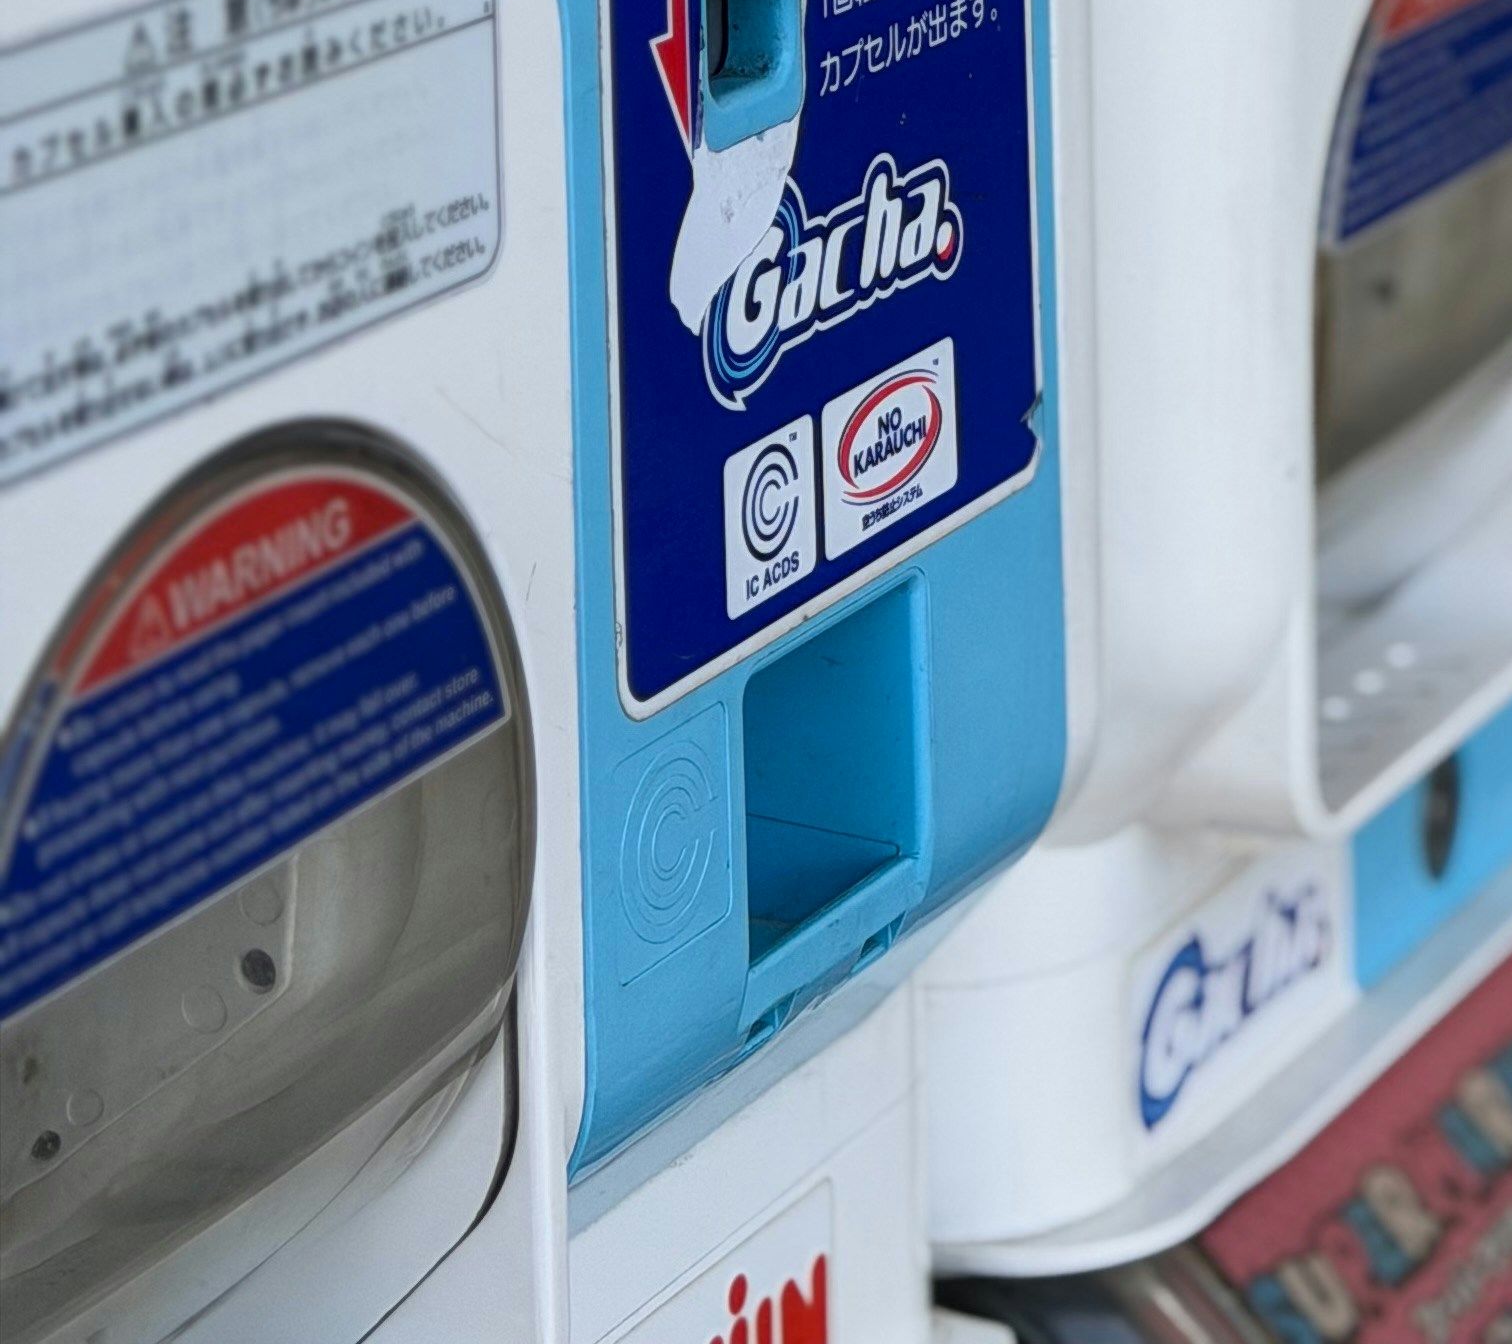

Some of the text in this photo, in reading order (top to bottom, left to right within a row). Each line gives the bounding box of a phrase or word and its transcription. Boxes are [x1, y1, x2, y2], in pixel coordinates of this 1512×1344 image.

[853, 415, 927, 478] KARAUCHI
[878, 406, 903, 439] NO
[166, 498, 353, 630] WARNING
[745, 551, 800, 601] IC ACDS
[444, 670, 477, 701] store
